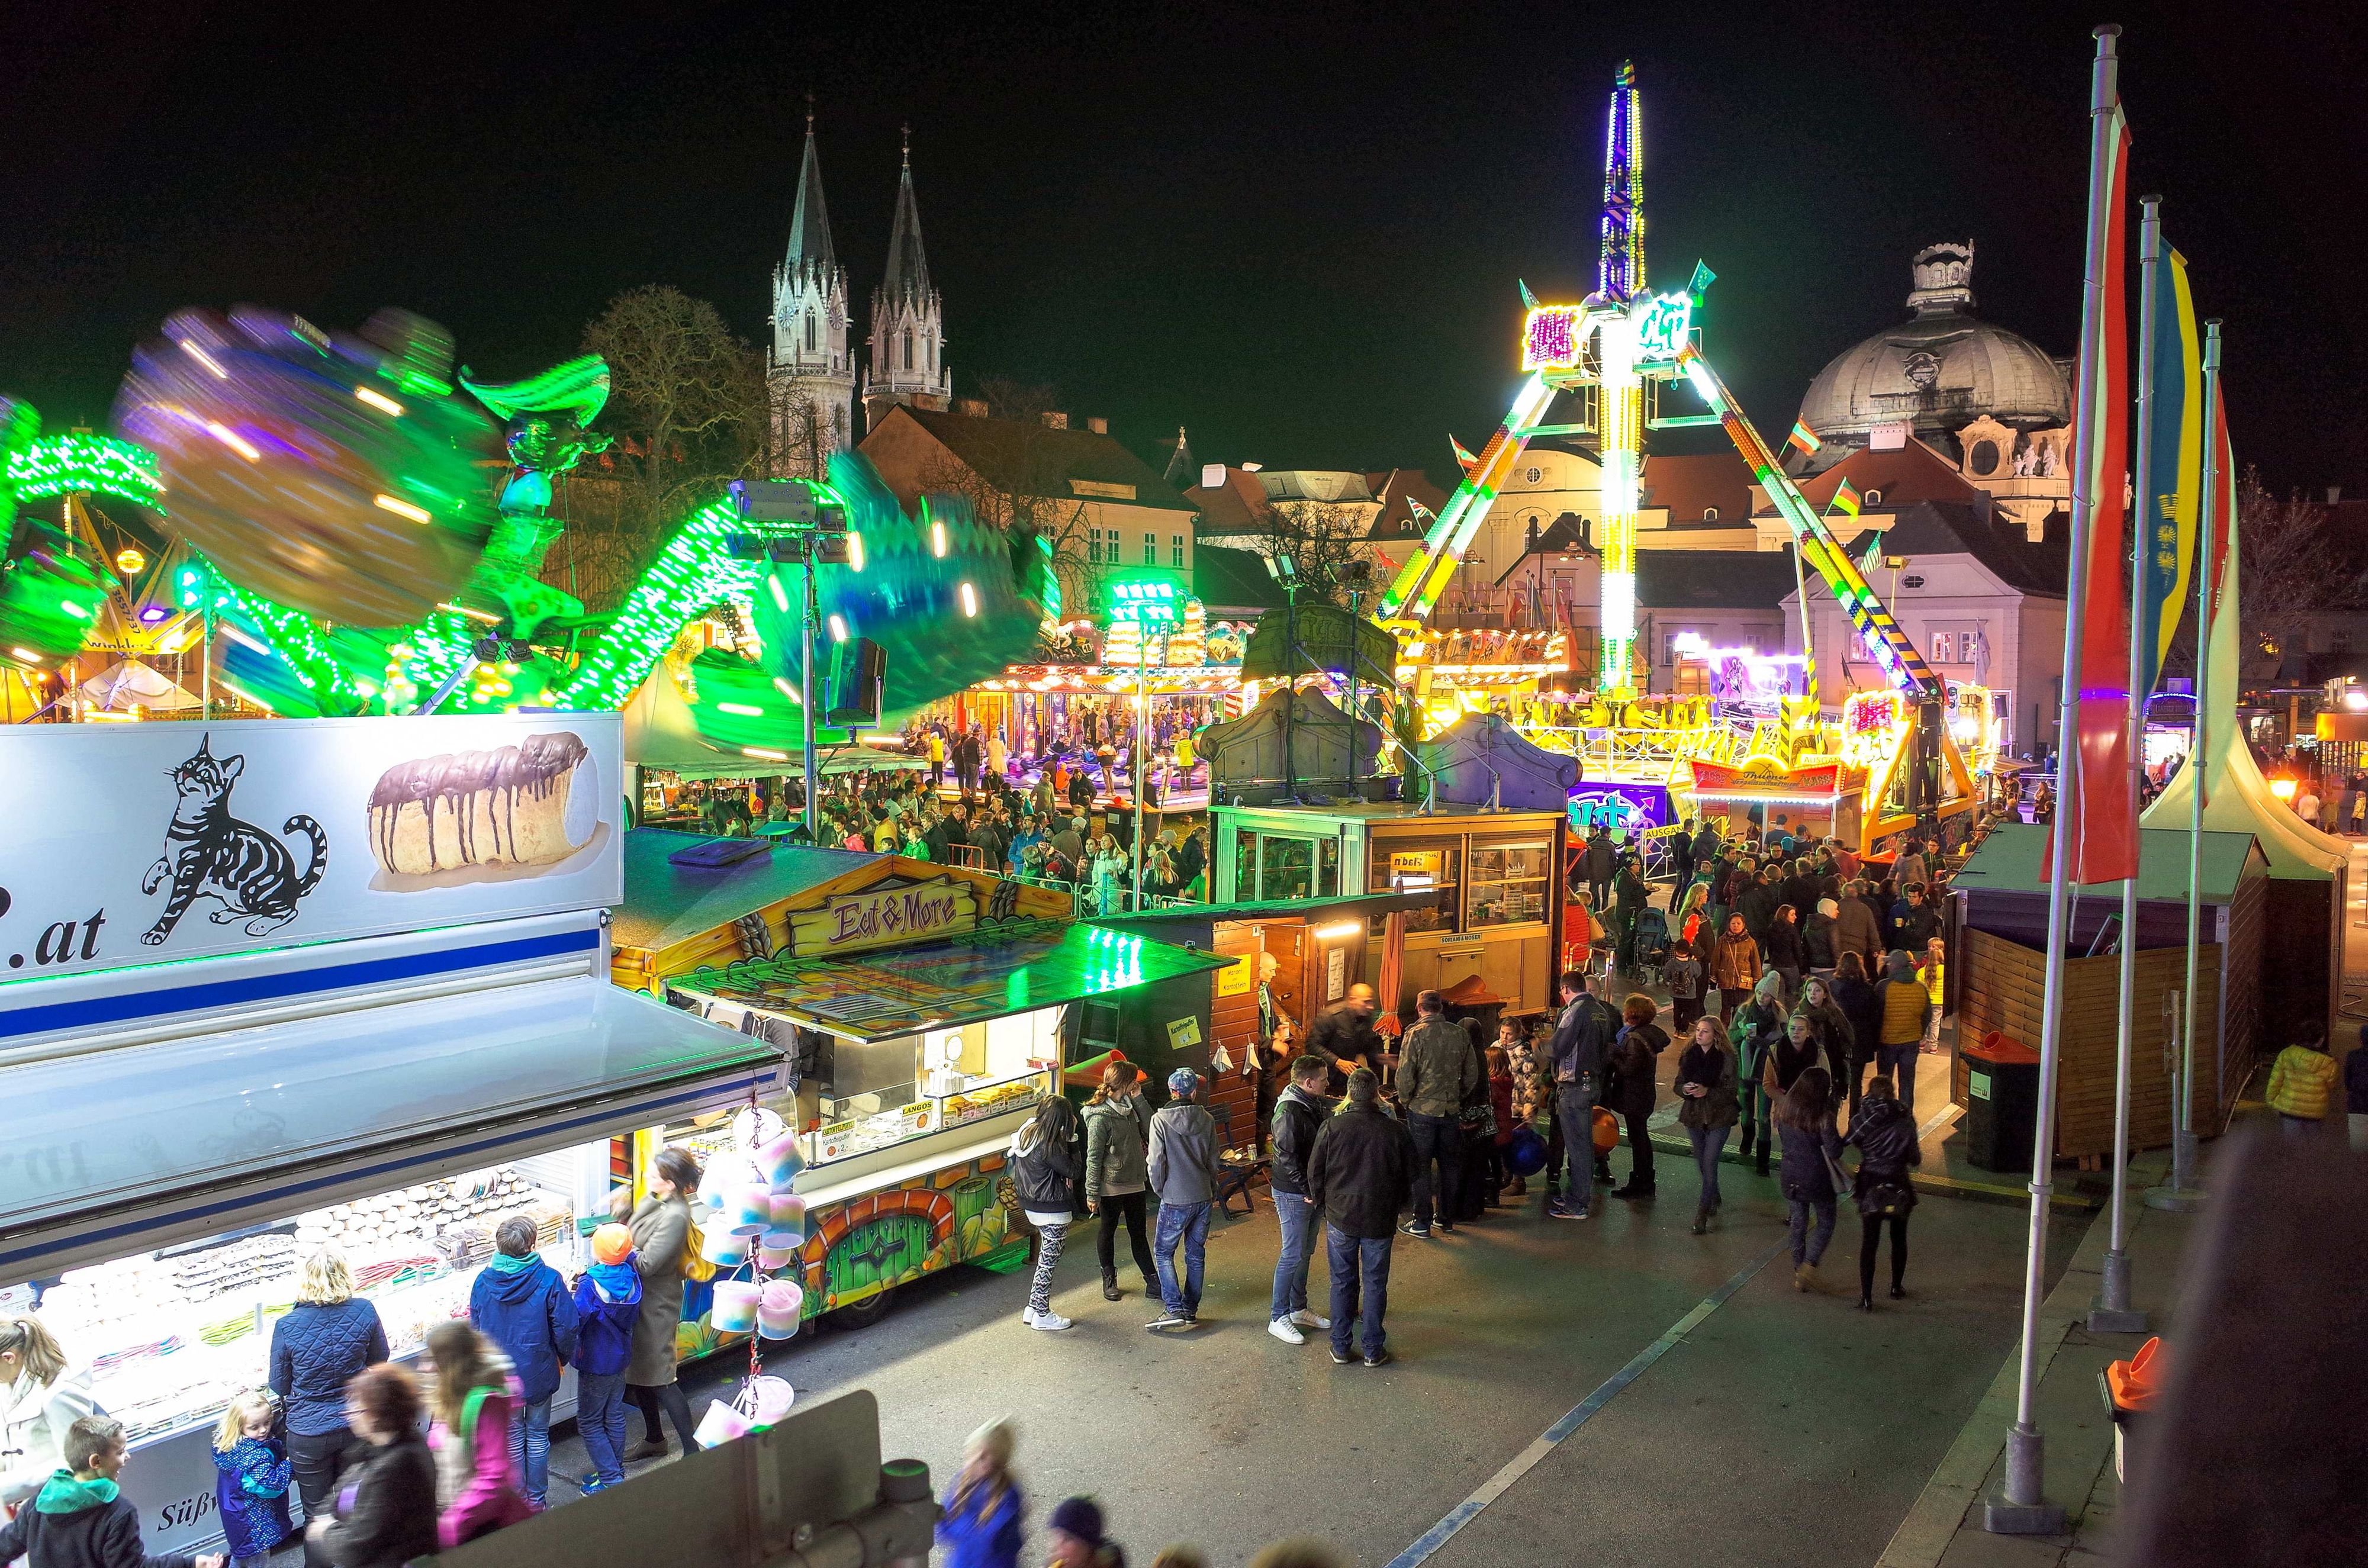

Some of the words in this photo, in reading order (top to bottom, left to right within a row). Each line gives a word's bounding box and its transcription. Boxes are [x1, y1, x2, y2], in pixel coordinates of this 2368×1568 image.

[829, 898, 880, 944] Eat
[881, 894, 902, 932] &
[901, 890, 957, 935] More
[903, 1102, 932, 1114] LANGOS
